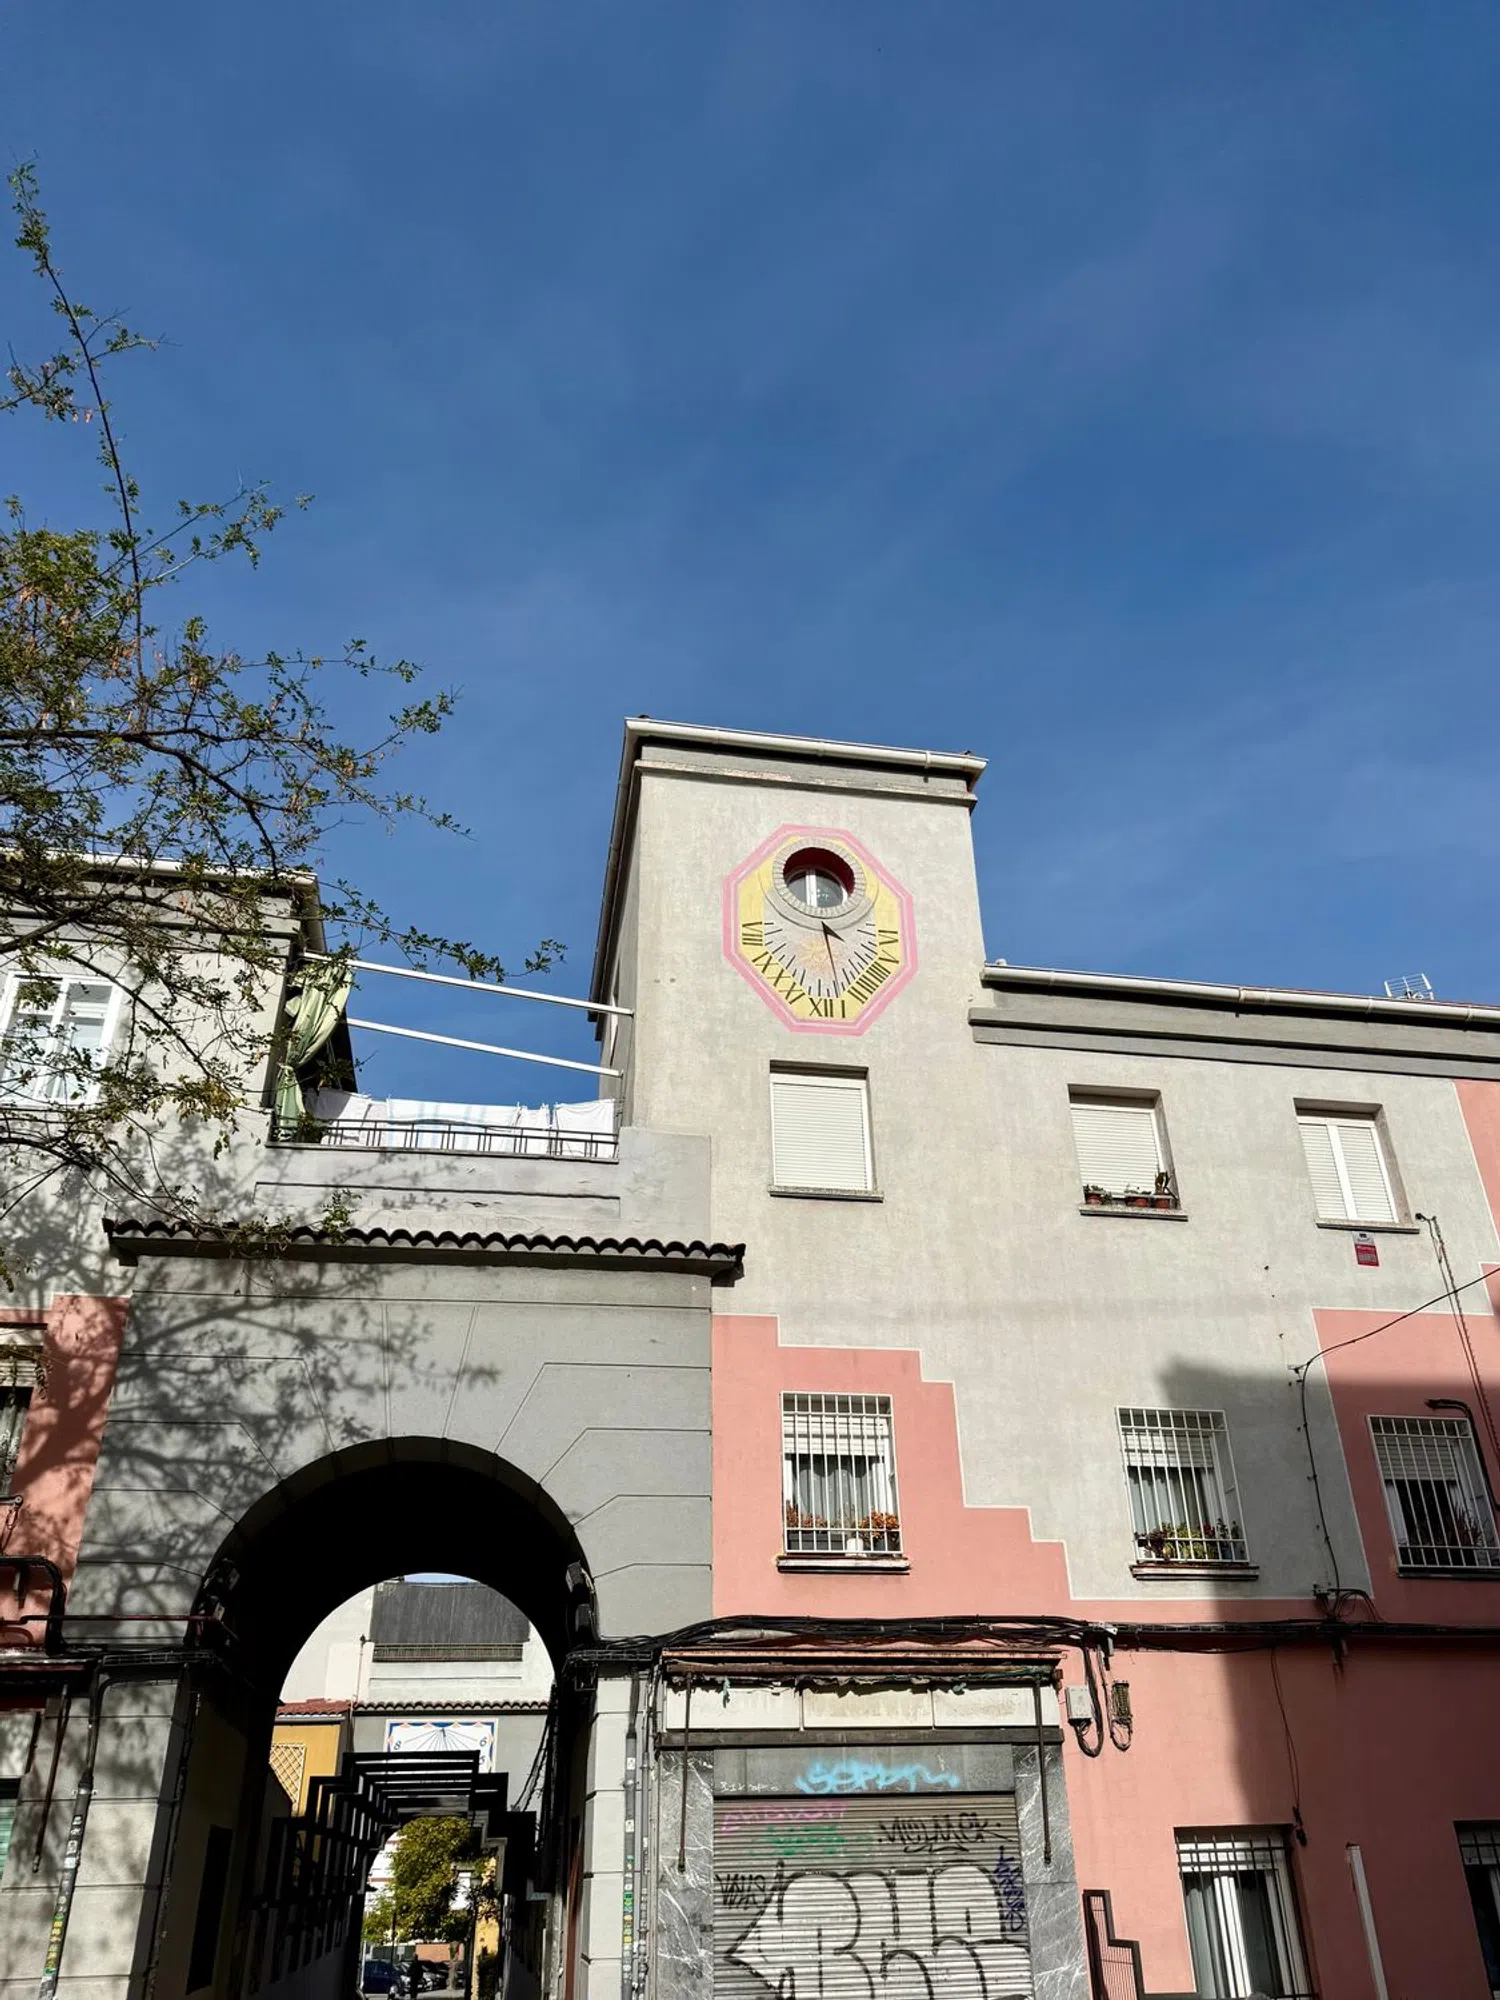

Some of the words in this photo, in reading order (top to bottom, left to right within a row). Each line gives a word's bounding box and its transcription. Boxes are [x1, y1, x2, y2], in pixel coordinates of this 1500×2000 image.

[742, 922, 763, 946] VIII
[878, 929, 899, 945] VI
[752, 951, 779, 974] IX
[878, 950, 899, 964] V
[767, 967, 791, 987] X
[856, 974, 879, 995] III
[778, 981, 805, 1005] XI
[847, 986, 868, 1004] II
[809, 997, 834, 1018] XII
[841, 1000, 846, 1018] I
[393, 1740, 402, 1751] 8
[480, 1736, 488, 1747] 6
